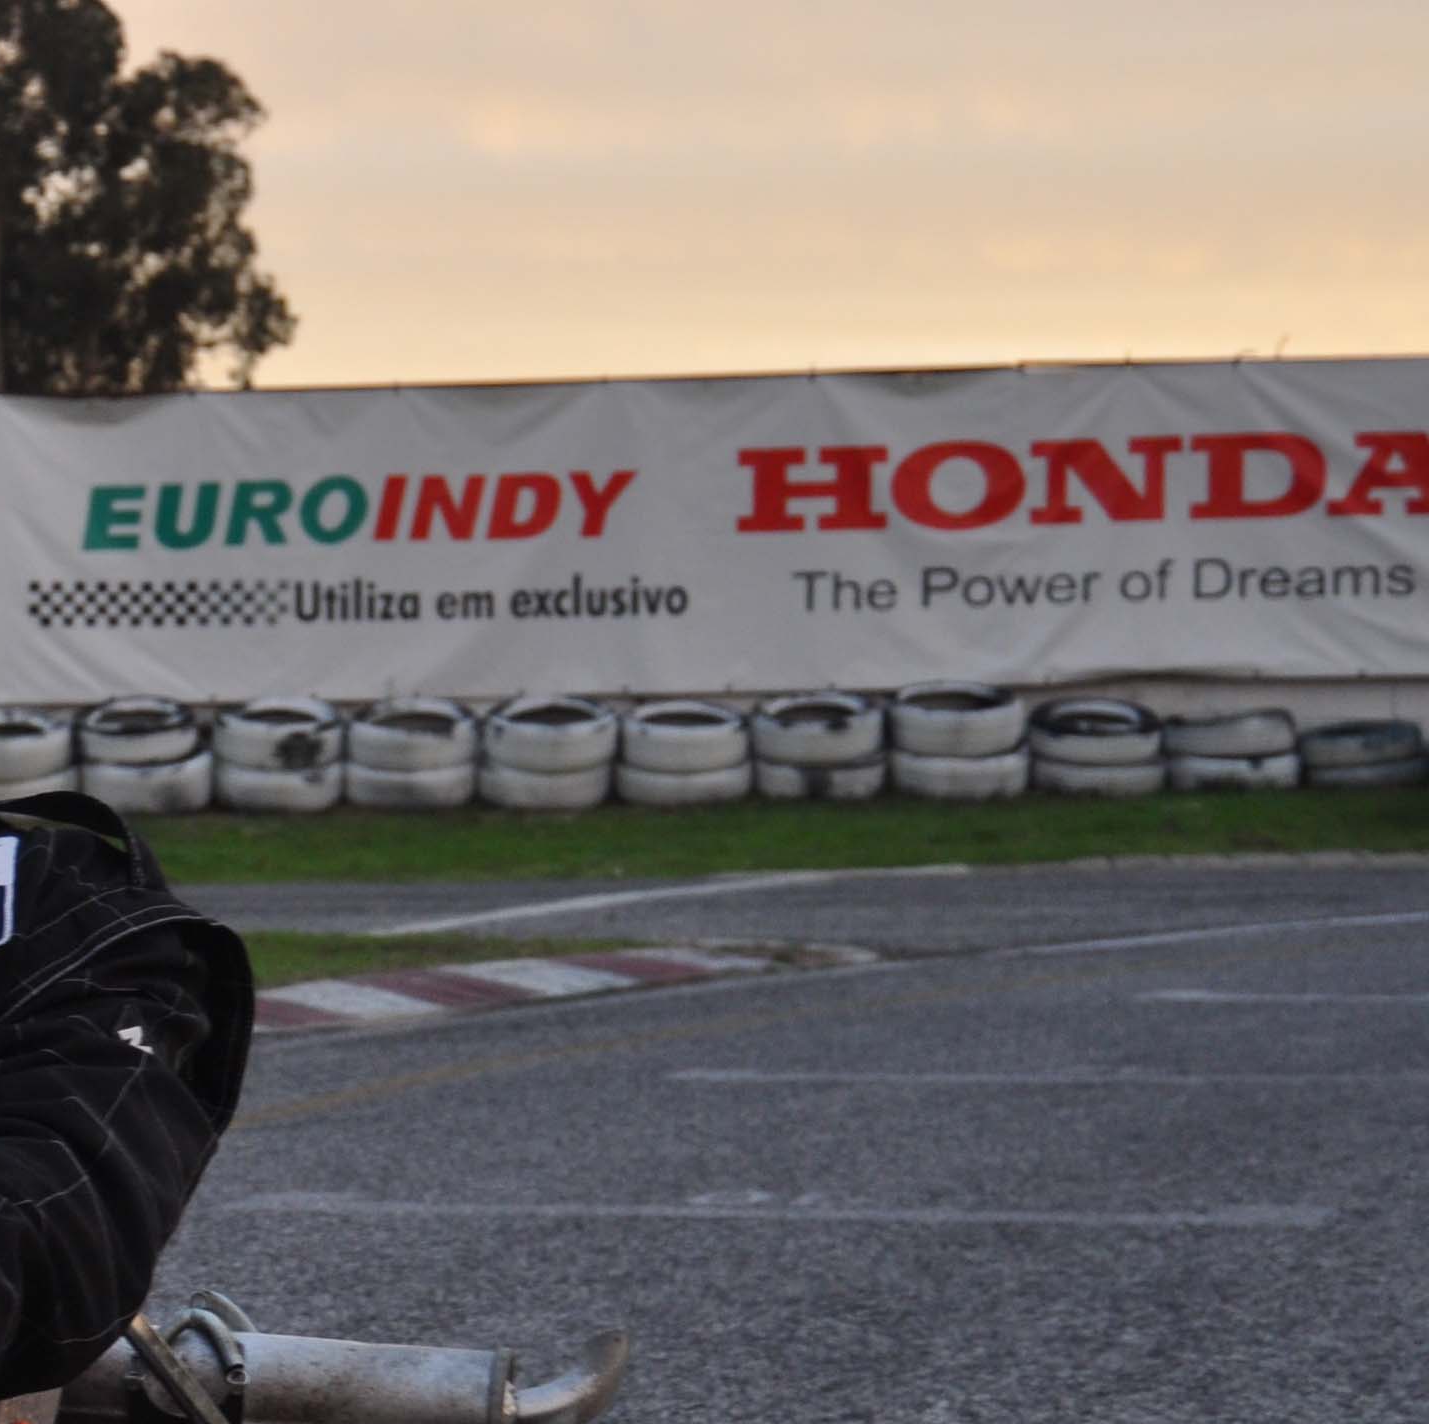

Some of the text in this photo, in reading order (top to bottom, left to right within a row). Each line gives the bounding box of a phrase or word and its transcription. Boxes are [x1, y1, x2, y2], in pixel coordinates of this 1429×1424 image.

[82, 471, 637, 551] EUROINDY
[736, 431, 1429, 534] HONDA
[293, 574, 690, 622] Utiliza em exclusivo
[793, 556, 1416, 613] The Power of Dreams
